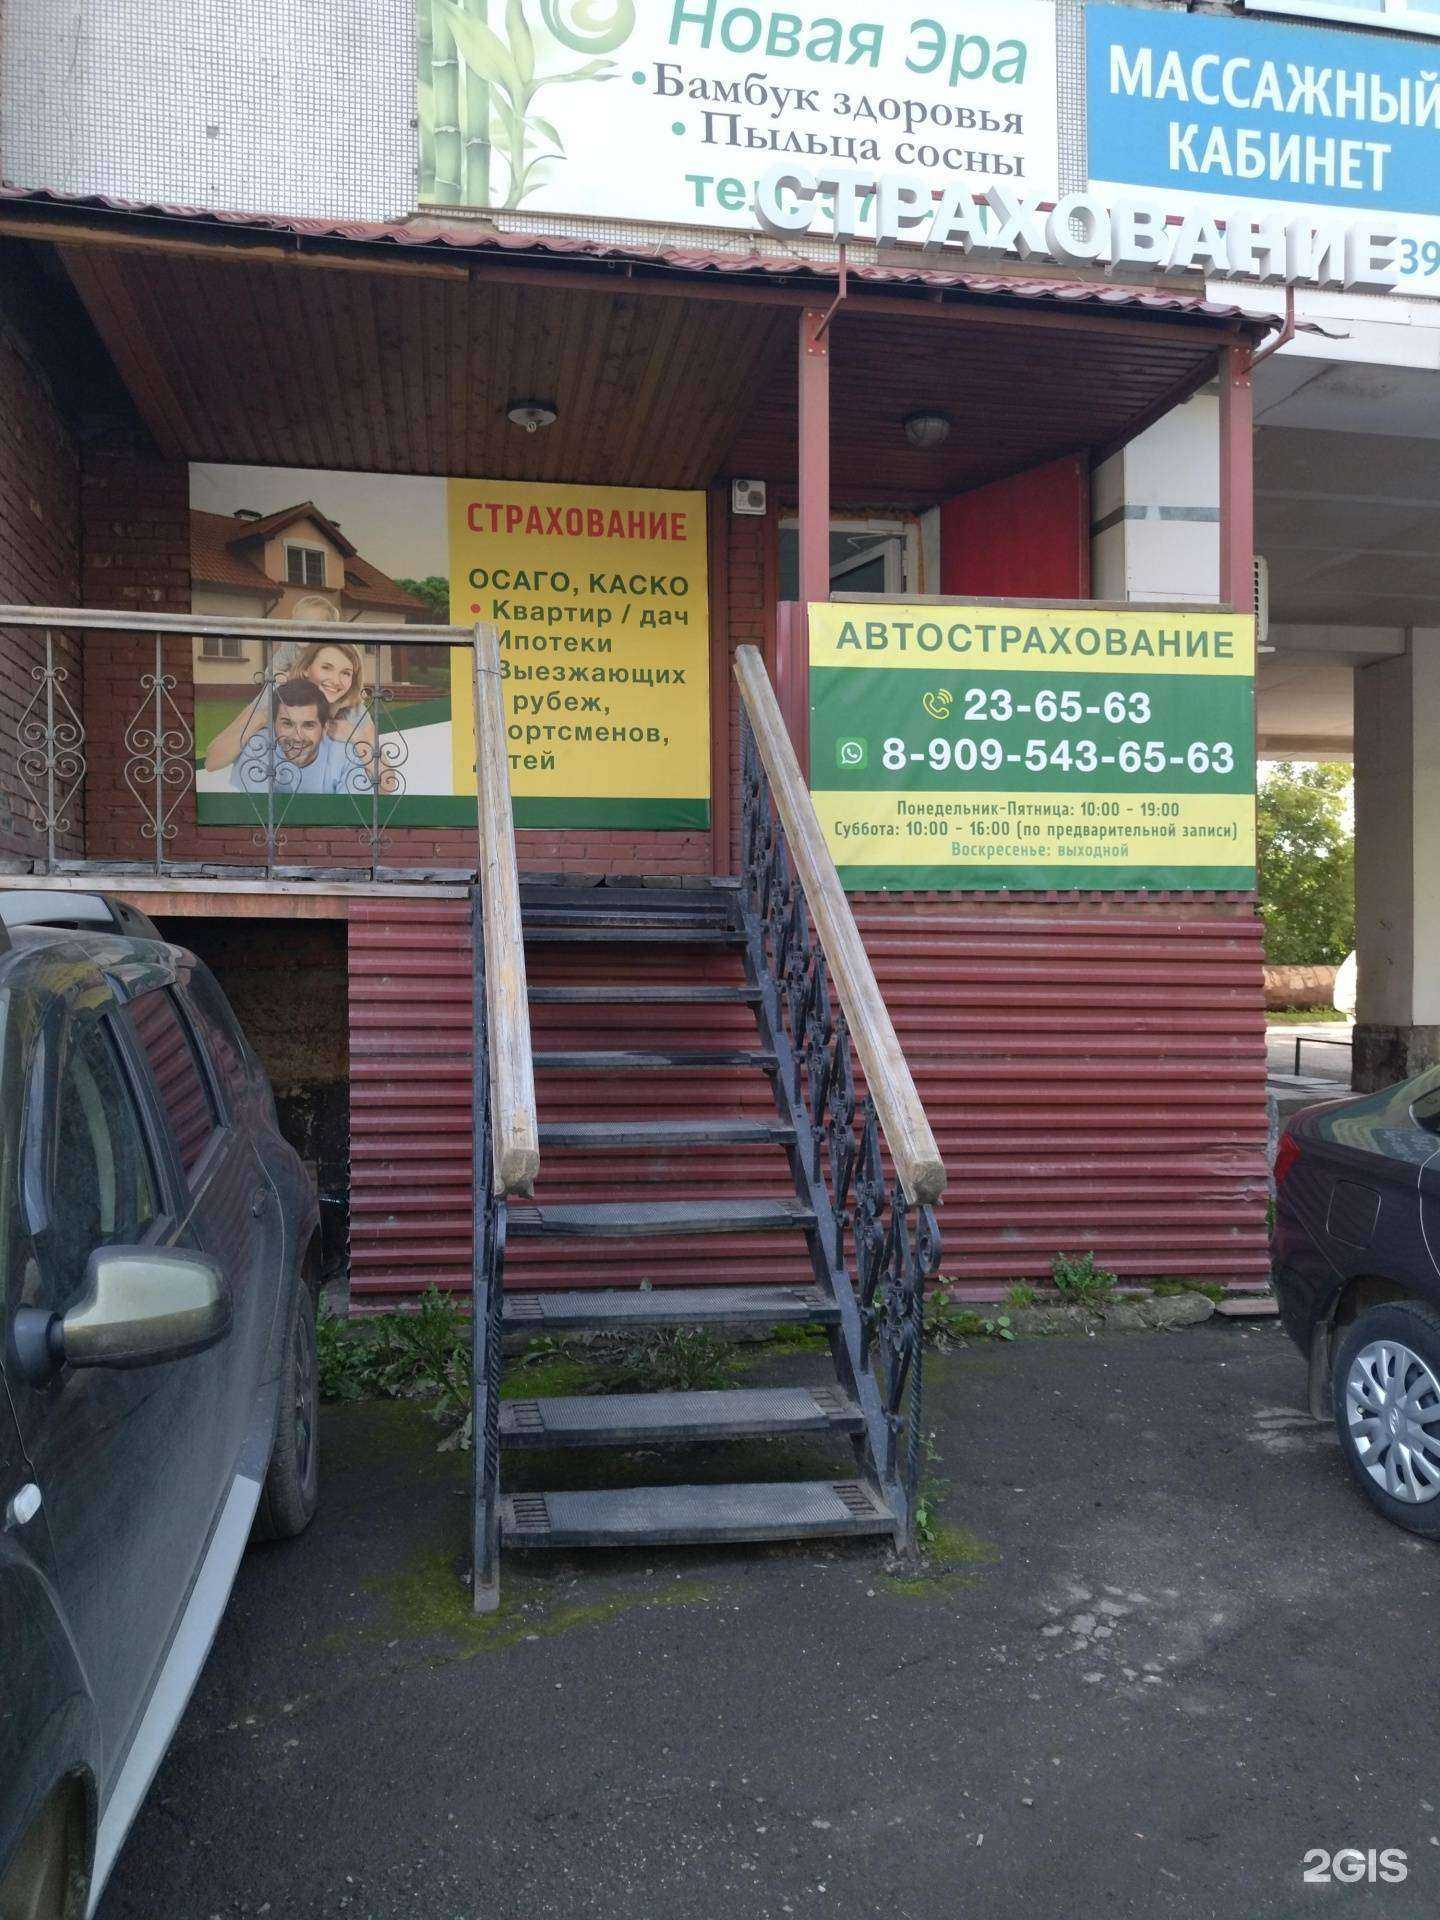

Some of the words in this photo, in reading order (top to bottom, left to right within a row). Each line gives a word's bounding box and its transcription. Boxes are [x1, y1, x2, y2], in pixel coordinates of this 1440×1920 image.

[668, 0, 884, 69] Новая
[905, 18, 1028, 88] Эра
[651, 61, 820, 120] Бамбук
[833, 92, 1025, 135] здоровья
[1109, 43, 1440, 130] МАССАЖНЫЙ
[700, 110, 881, 164] Пыльца
[894, 142, 1026, 178] сосны
[1168, 120, 1392, 193] КАБИНЕТ
[754, 163, 1400, 290] СТРАХОВАНИЕ
[466, 502, 688, 541] СТРАХОВАНИЕ
[468, 567, 579, 598] ОСАГО,
[589, 573, 689, 597] КАСКО
[492, 599, 613, 628] Квартир
[639, 608, 689, 629] дач
[835, 620, 1235, 660] АВТОСТРАХОВАНИЕ
[963, 687, 1152, 725] 23-65-63
[473, 723, 670, 746] ортсменов,
[881, 736, 1235, 775] 8-909-543-65-63
[897, 800, 1075, 818] Понедельник-Пятница:
[1080, 801, 1120, 817] 10:00
[1140, 802, 1180, 817] 19:00
[834, 821, 900, 839] Суббота:
[906, 821, 949, 836] 10:00
[969, 821, 1010, 836] 16:00
[1017, 821, 1040, 840] (по
[1047, 822, 1176, 840] предварительной
[1182, 822, 1238, 841] записи)
[951, 841, 1051, 860] Воскресенье:
[1057, 843, 1129, 859] выходной
